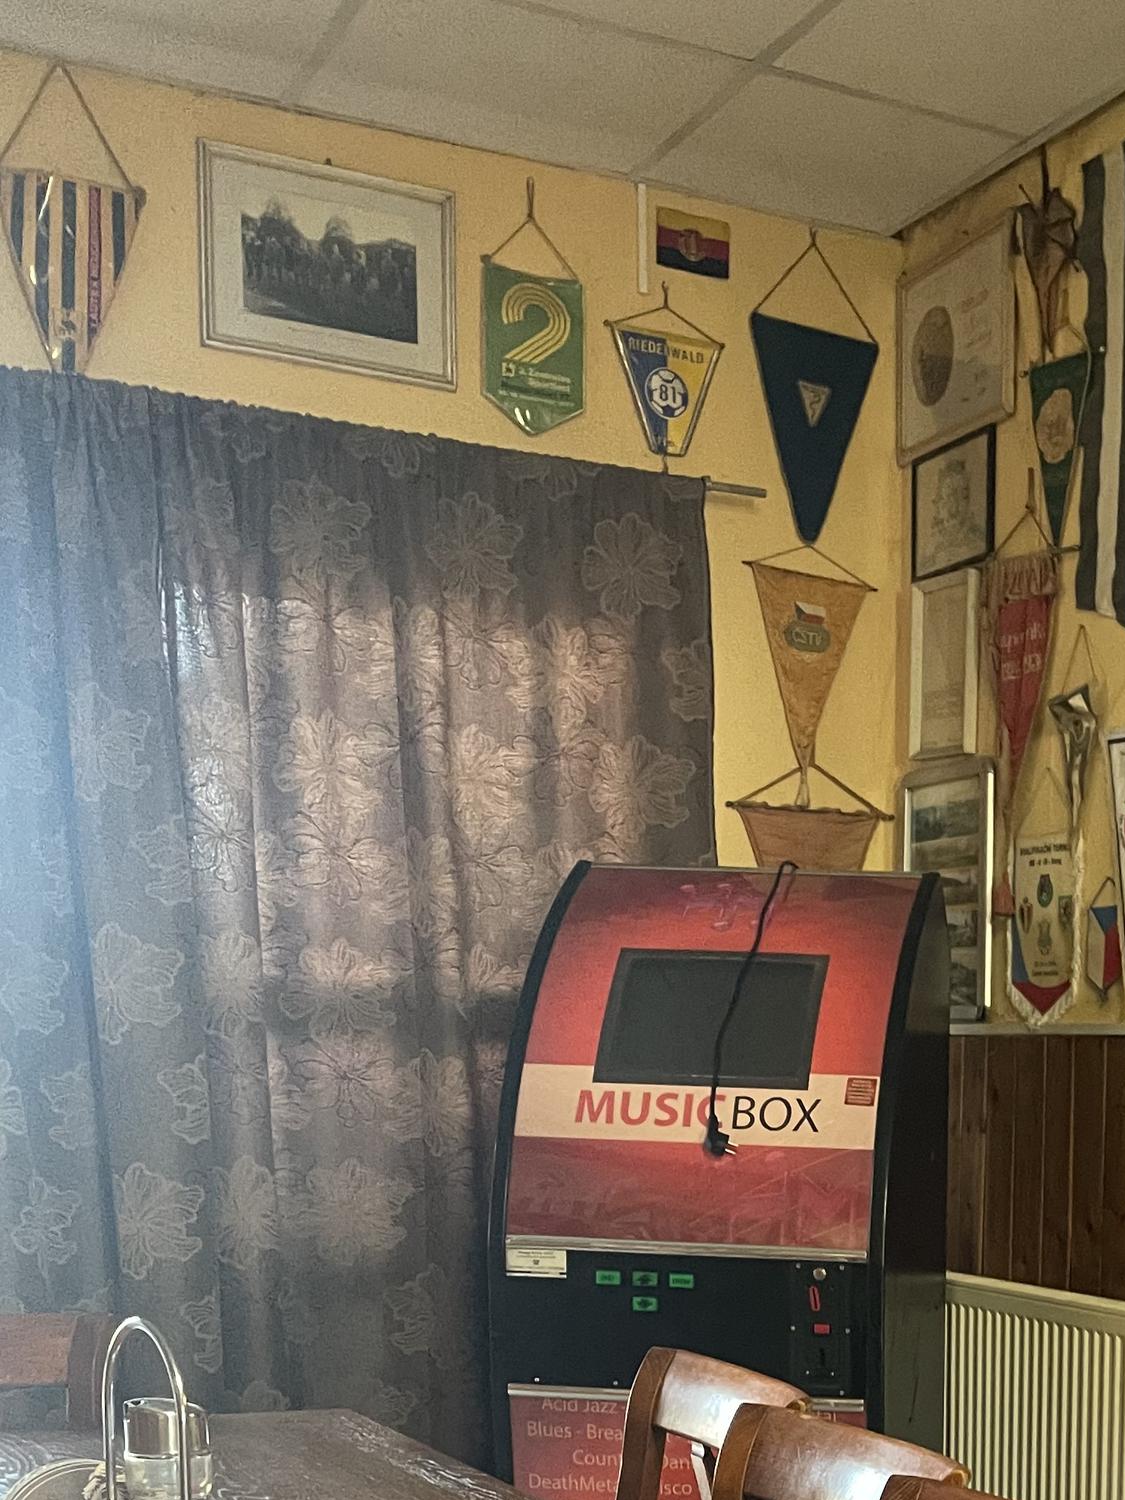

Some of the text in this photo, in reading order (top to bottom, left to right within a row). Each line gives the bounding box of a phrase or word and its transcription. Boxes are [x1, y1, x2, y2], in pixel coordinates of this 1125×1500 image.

[658, 382, 679, 404] 81
[574, 1089, 822, 1133] MUSIC BOX
[541, 1397, 619, 1414] Acid Jazz
[527, 1420, 572, 1439] Blues
[572, 1449, 623, 1467] Coun
